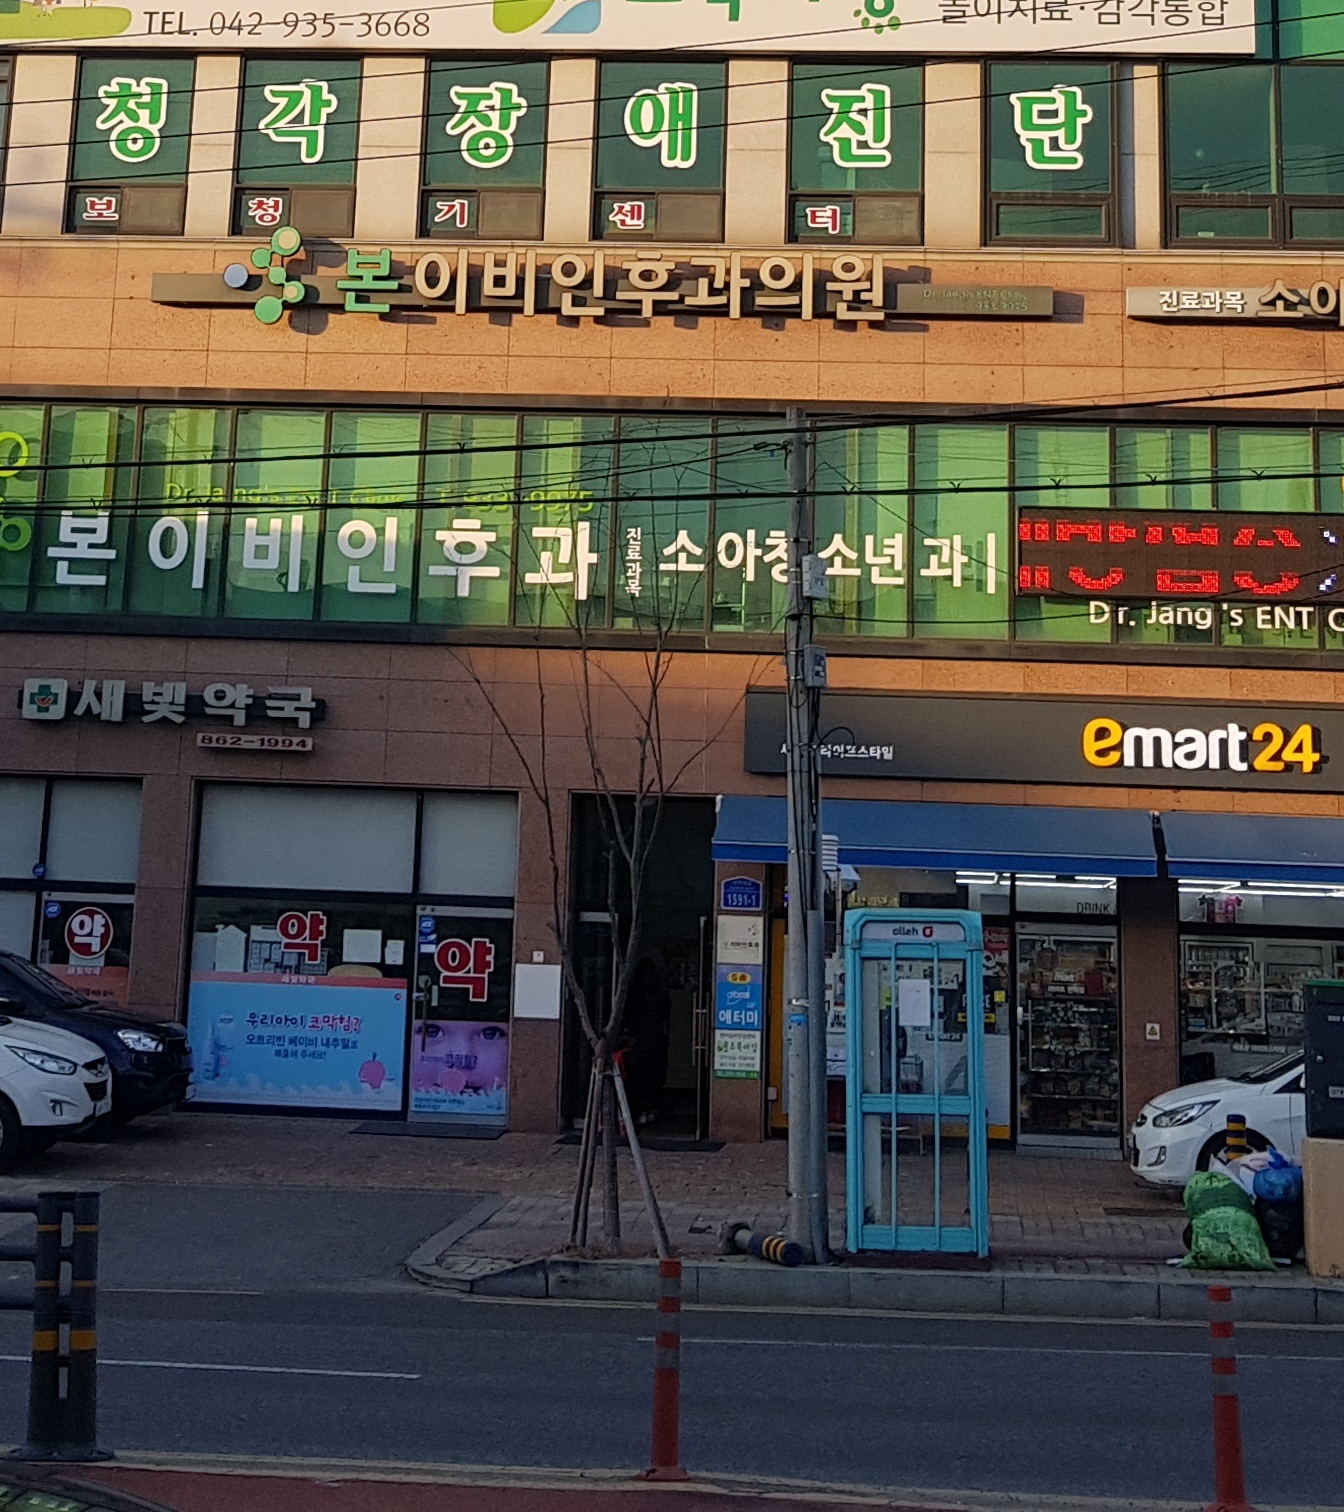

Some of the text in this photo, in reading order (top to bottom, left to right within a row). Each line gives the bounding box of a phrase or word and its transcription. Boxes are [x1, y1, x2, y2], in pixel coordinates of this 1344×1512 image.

[143, 9, 431, 39] TEL. 042-935-3668
[336, 248, 885, 321] 본이비인후과의원
[1158, 290, 1246, 314] 진료과목
[47, 509, 599, 602] 본이비인후과
[1088, 600, 1136, 627] Dr.
[1256, 605, 1314, 630] ENT
[201, 734, 309, 750] 862-1994
[1080, 715, 1321, 775] emart24
[70, 913, 107, 953] 약
[277, 910, 327, 965] 약
[892, 925, 919, 936] olleh
[434, 938, 495, 1002] 약
[718, 1009, 759, 1027] 애터미
